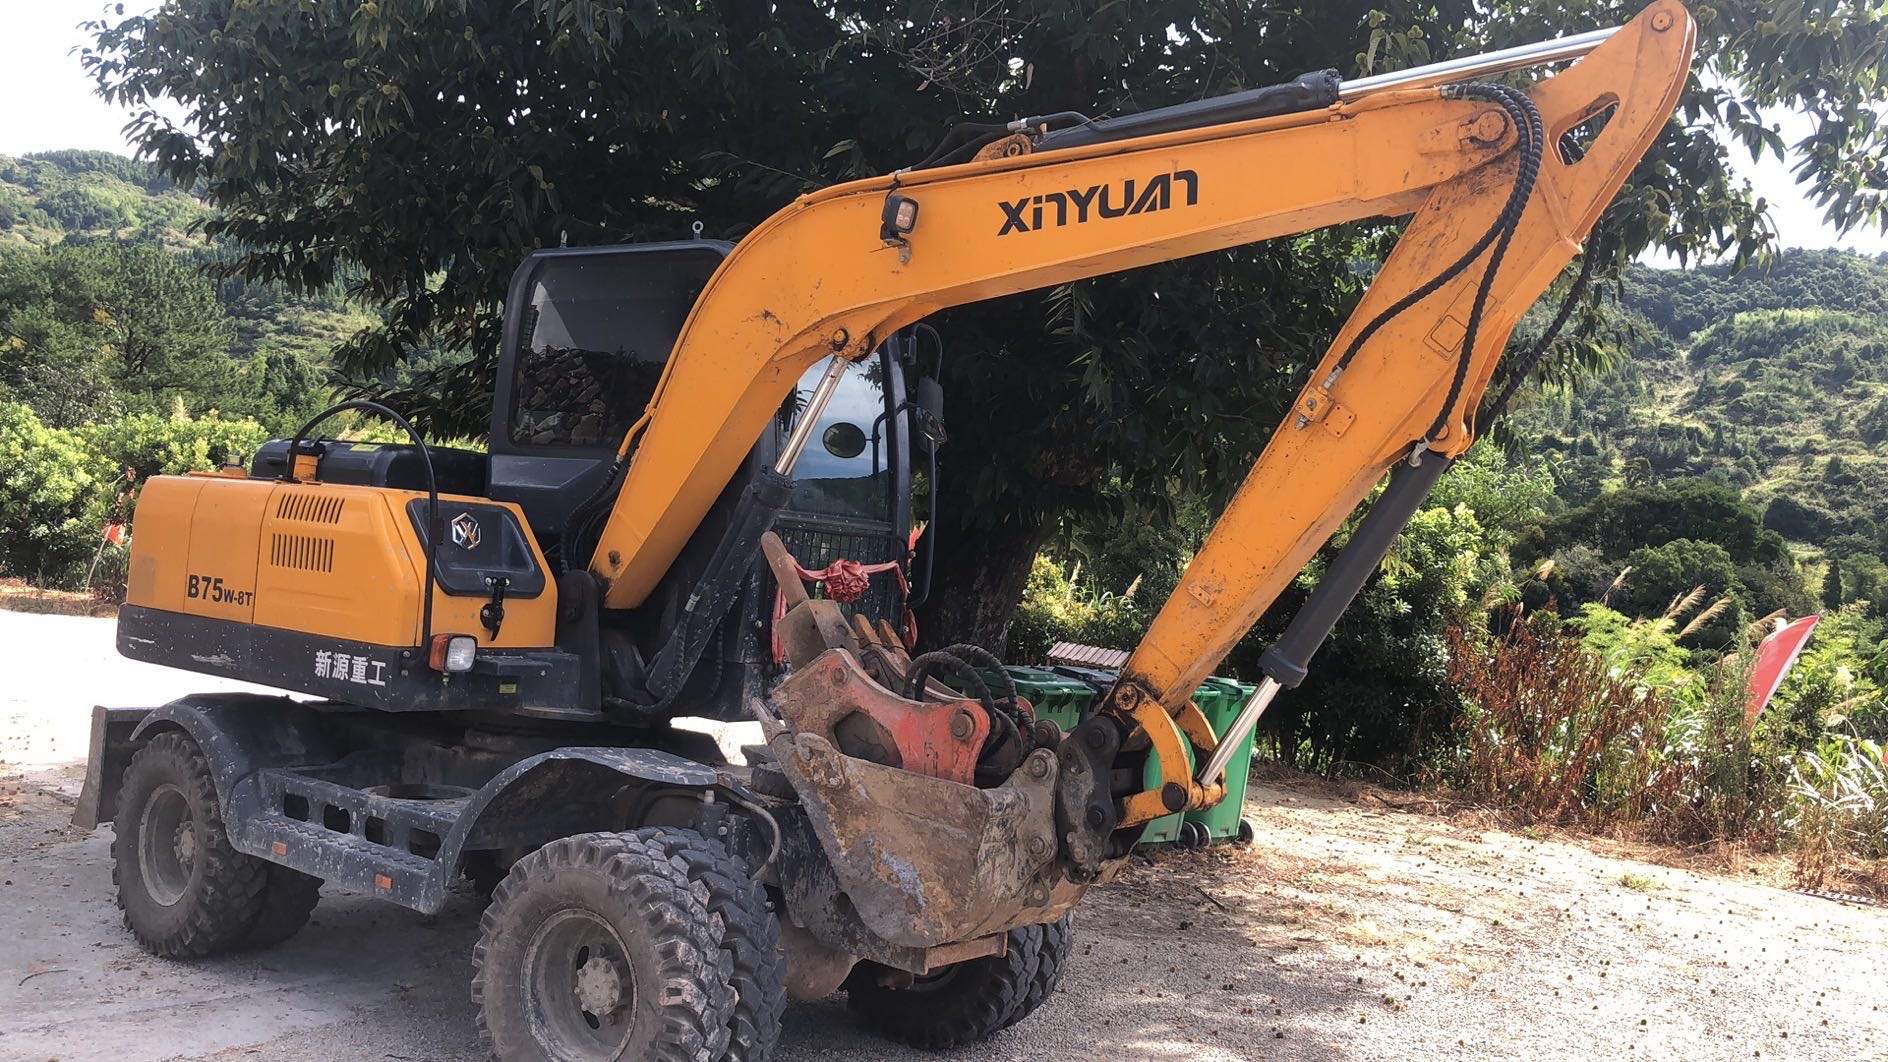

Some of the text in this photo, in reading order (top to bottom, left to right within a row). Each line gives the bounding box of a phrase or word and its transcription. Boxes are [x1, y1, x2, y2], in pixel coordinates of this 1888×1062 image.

[187, 574, 253, 607] B75W-8T
[315, 649, 387, 687] 新源重工
